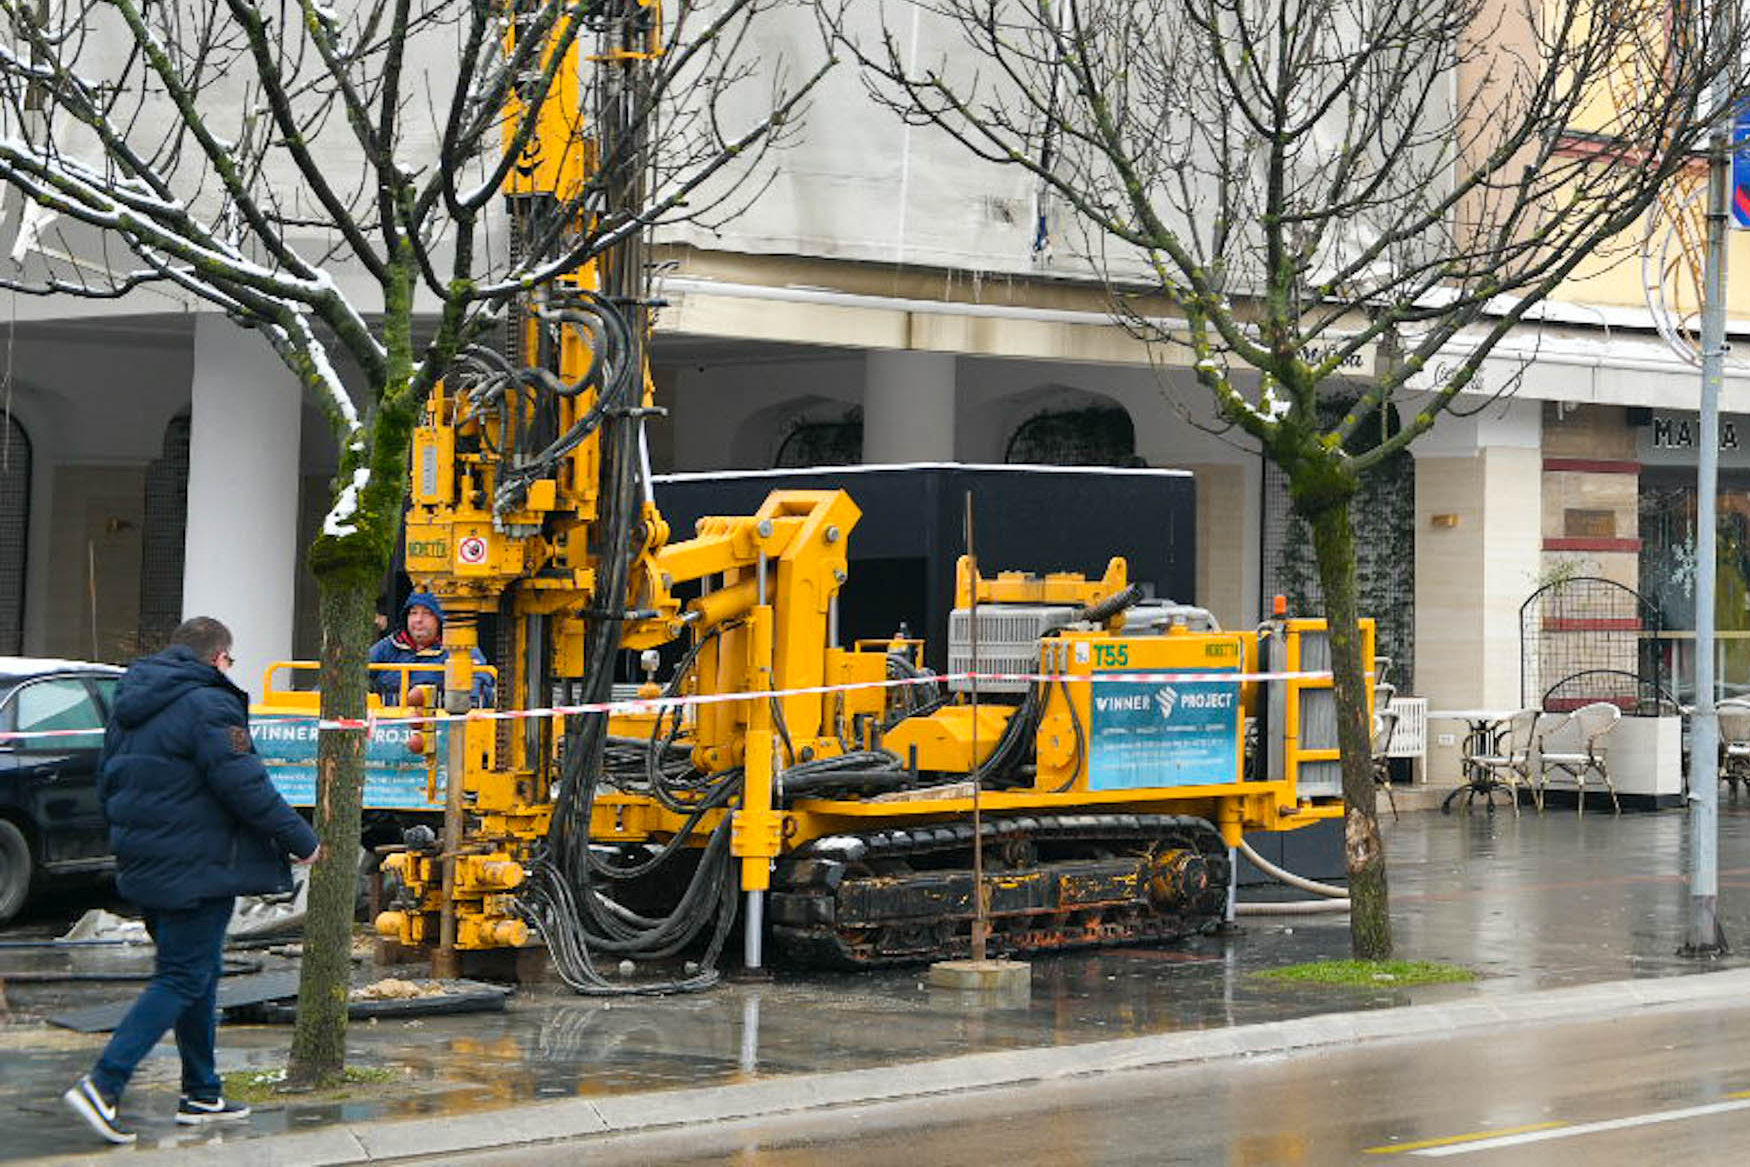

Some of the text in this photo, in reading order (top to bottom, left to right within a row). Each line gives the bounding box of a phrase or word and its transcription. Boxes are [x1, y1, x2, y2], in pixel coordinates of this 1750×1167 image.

[1653, 418, 1739, 450] МАА
[1093, 644, 1129, 667] T55
[1095, 693, 1233, 712] WINNER PROJECT
